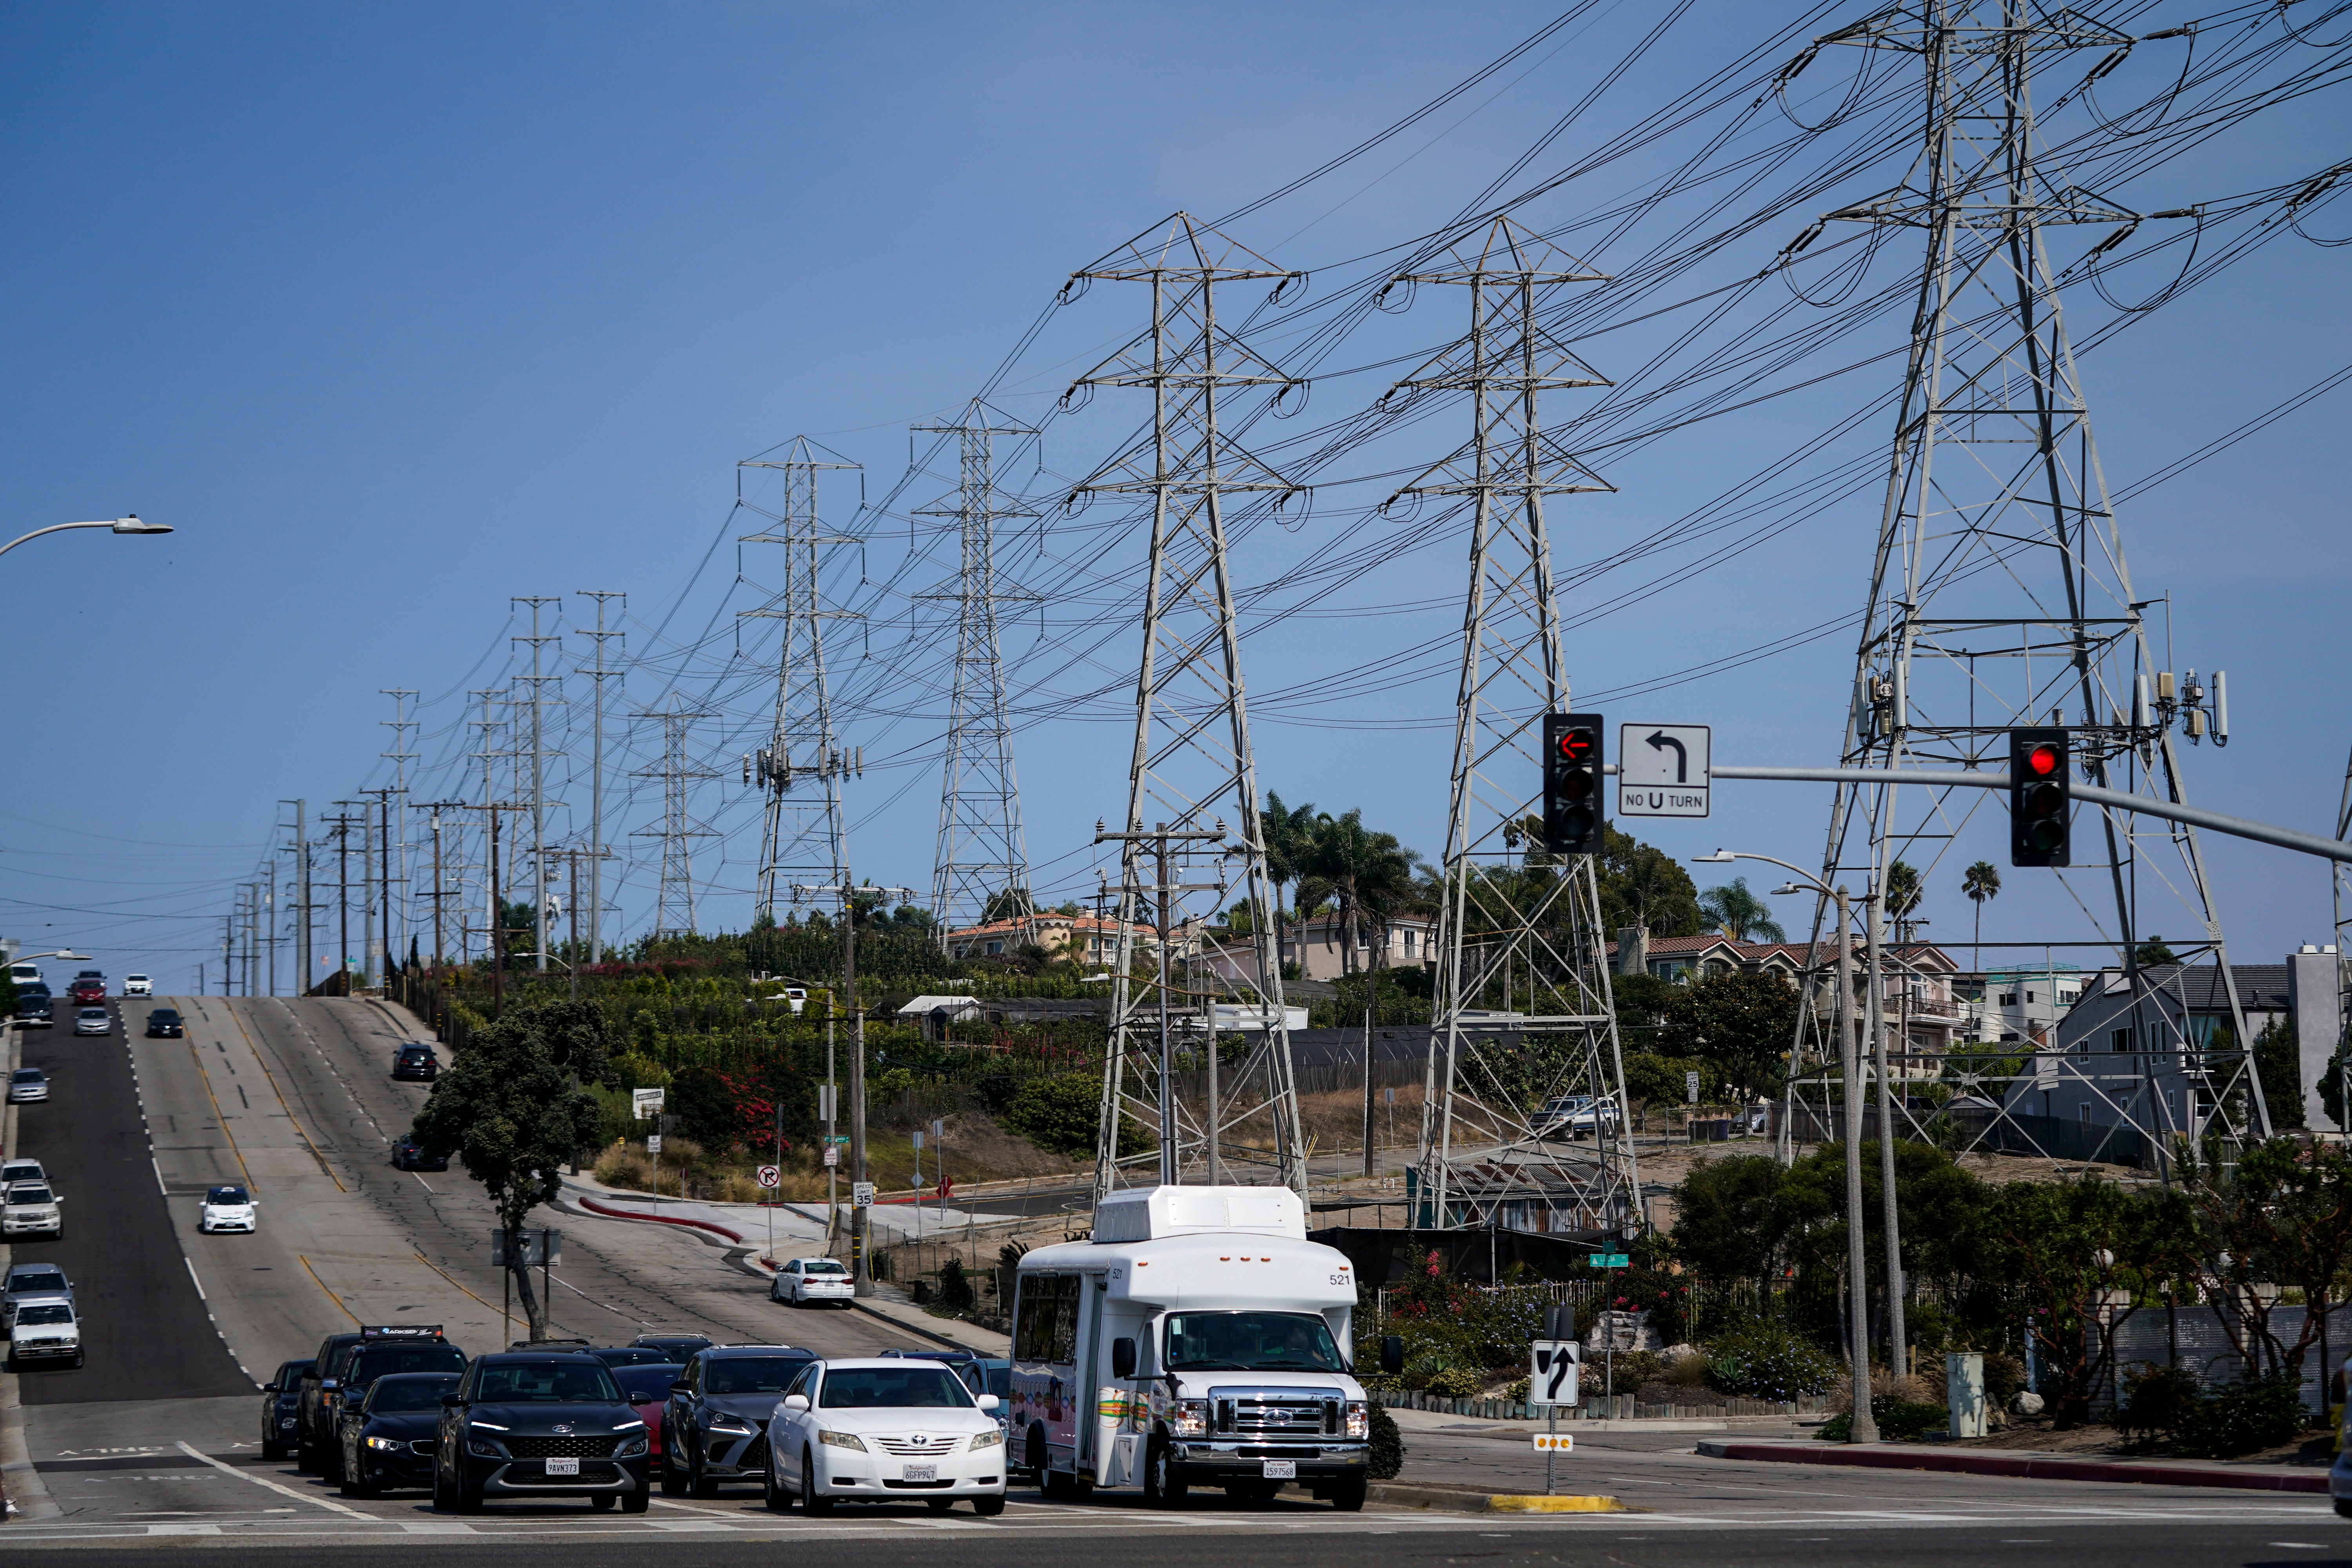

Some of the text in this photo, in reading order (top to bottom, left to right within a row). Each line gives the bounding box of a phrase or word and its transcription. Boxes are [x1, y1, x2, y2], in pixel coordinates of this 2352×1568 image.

[1626, 793, 1702, 809] NO U TURN
[857, 1195, 871, 1204] 35
[1112, 1269, 1123, 1279] 521
[1330, 1275, 1349, 1285] 521
[548, 1464, 577, 1472] 9AVN373
[906, 1471, 935, 1479] 6GFP947
